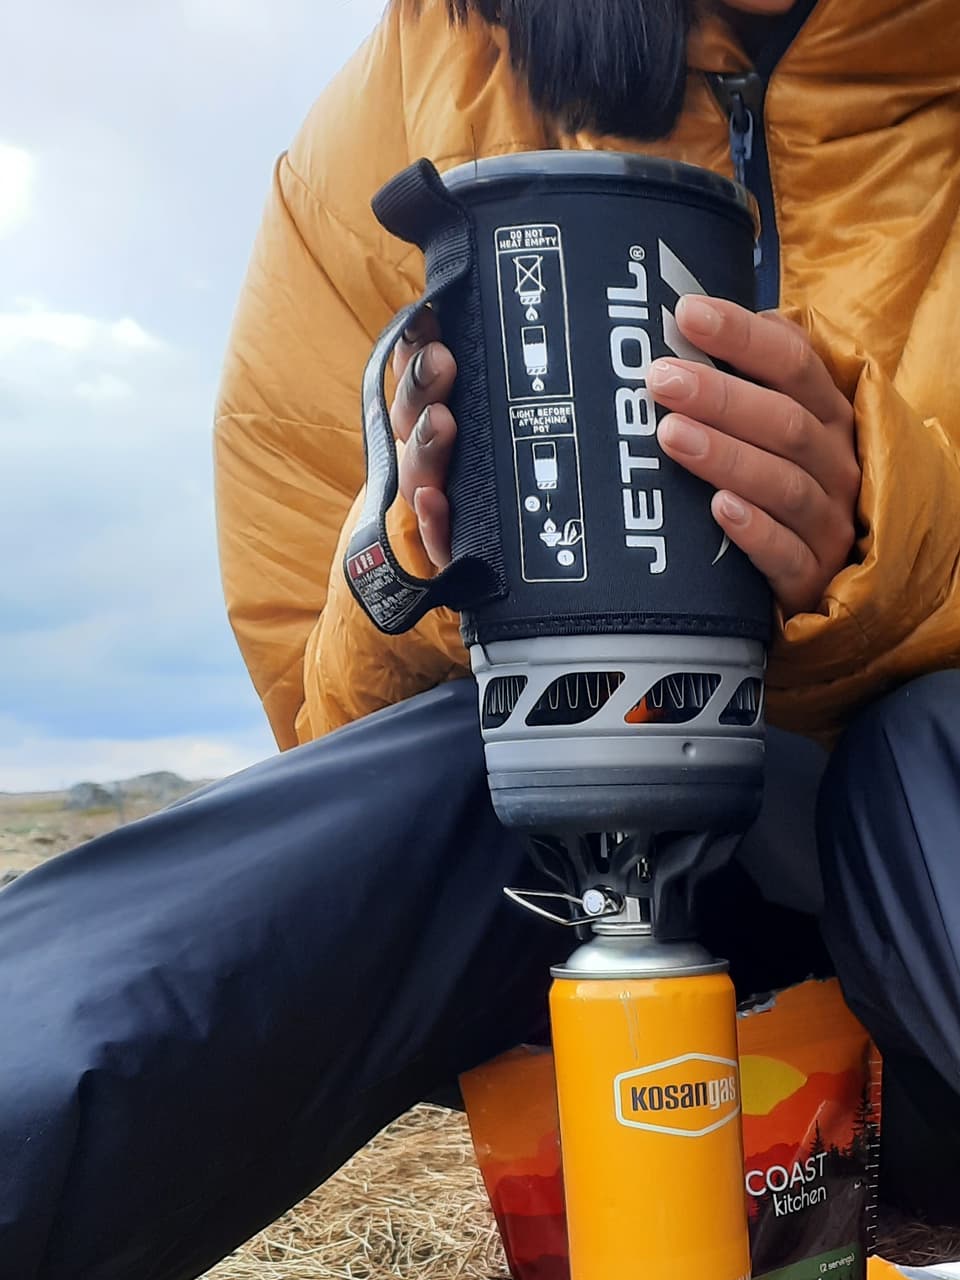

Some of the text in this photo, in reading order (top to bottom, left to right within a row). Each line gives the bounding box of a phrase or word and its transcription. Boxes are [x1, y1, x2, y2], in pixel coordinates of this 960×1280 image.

[509, 228, 543, 240] DO NOT
[499, 236, 557, 249] HEAT EMPTY
[512, 407, 571, 419] LIGHT BEFORE
[606, 260, 668, 575] JETBOIL
[518, 415, 568, 427] ATTACHING
[533, 425, 550, 434] POT
[745, 1152, 828, 1196] COAST
[773, 1185, 827, 1217] kitchen
